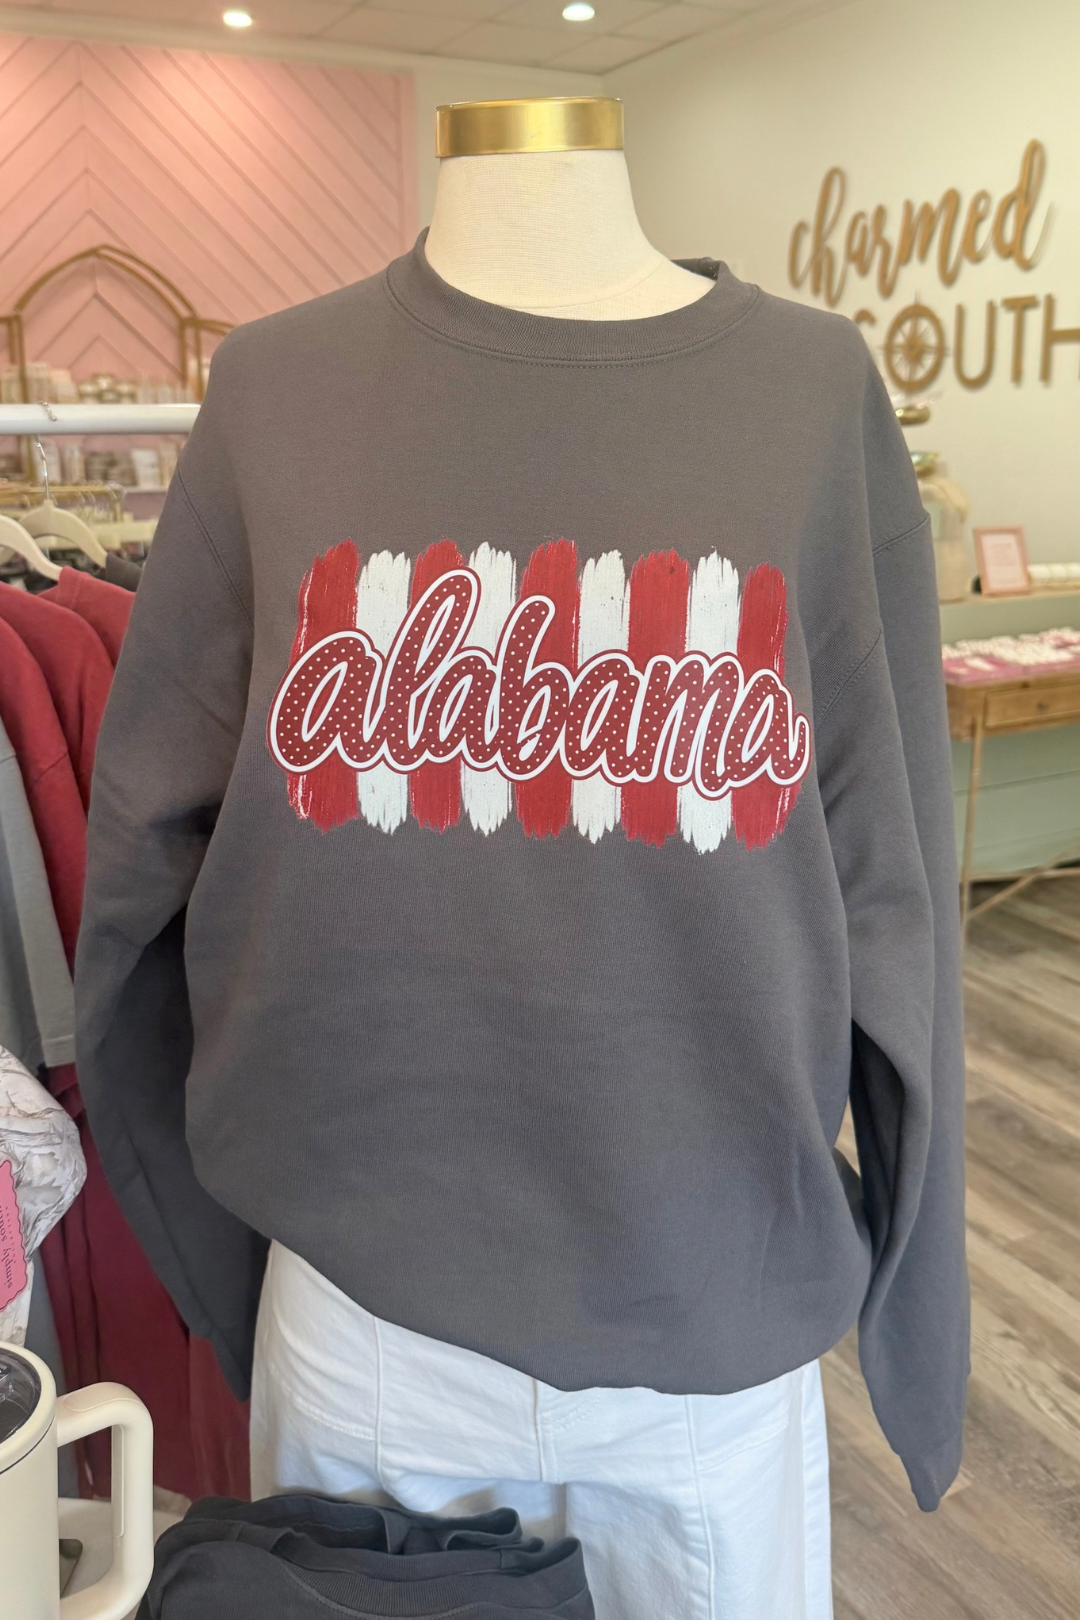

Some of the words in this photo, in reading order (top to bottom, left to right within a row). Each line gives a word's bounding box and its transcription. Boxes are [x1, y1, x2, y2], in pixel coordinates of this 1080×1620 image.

[788, 138, 1054, 309] charmed
[855, 293, 1080, 394] OUTH
[267, 569, 811, 799] alabama
[1, 1248, 14, 1289] simply
